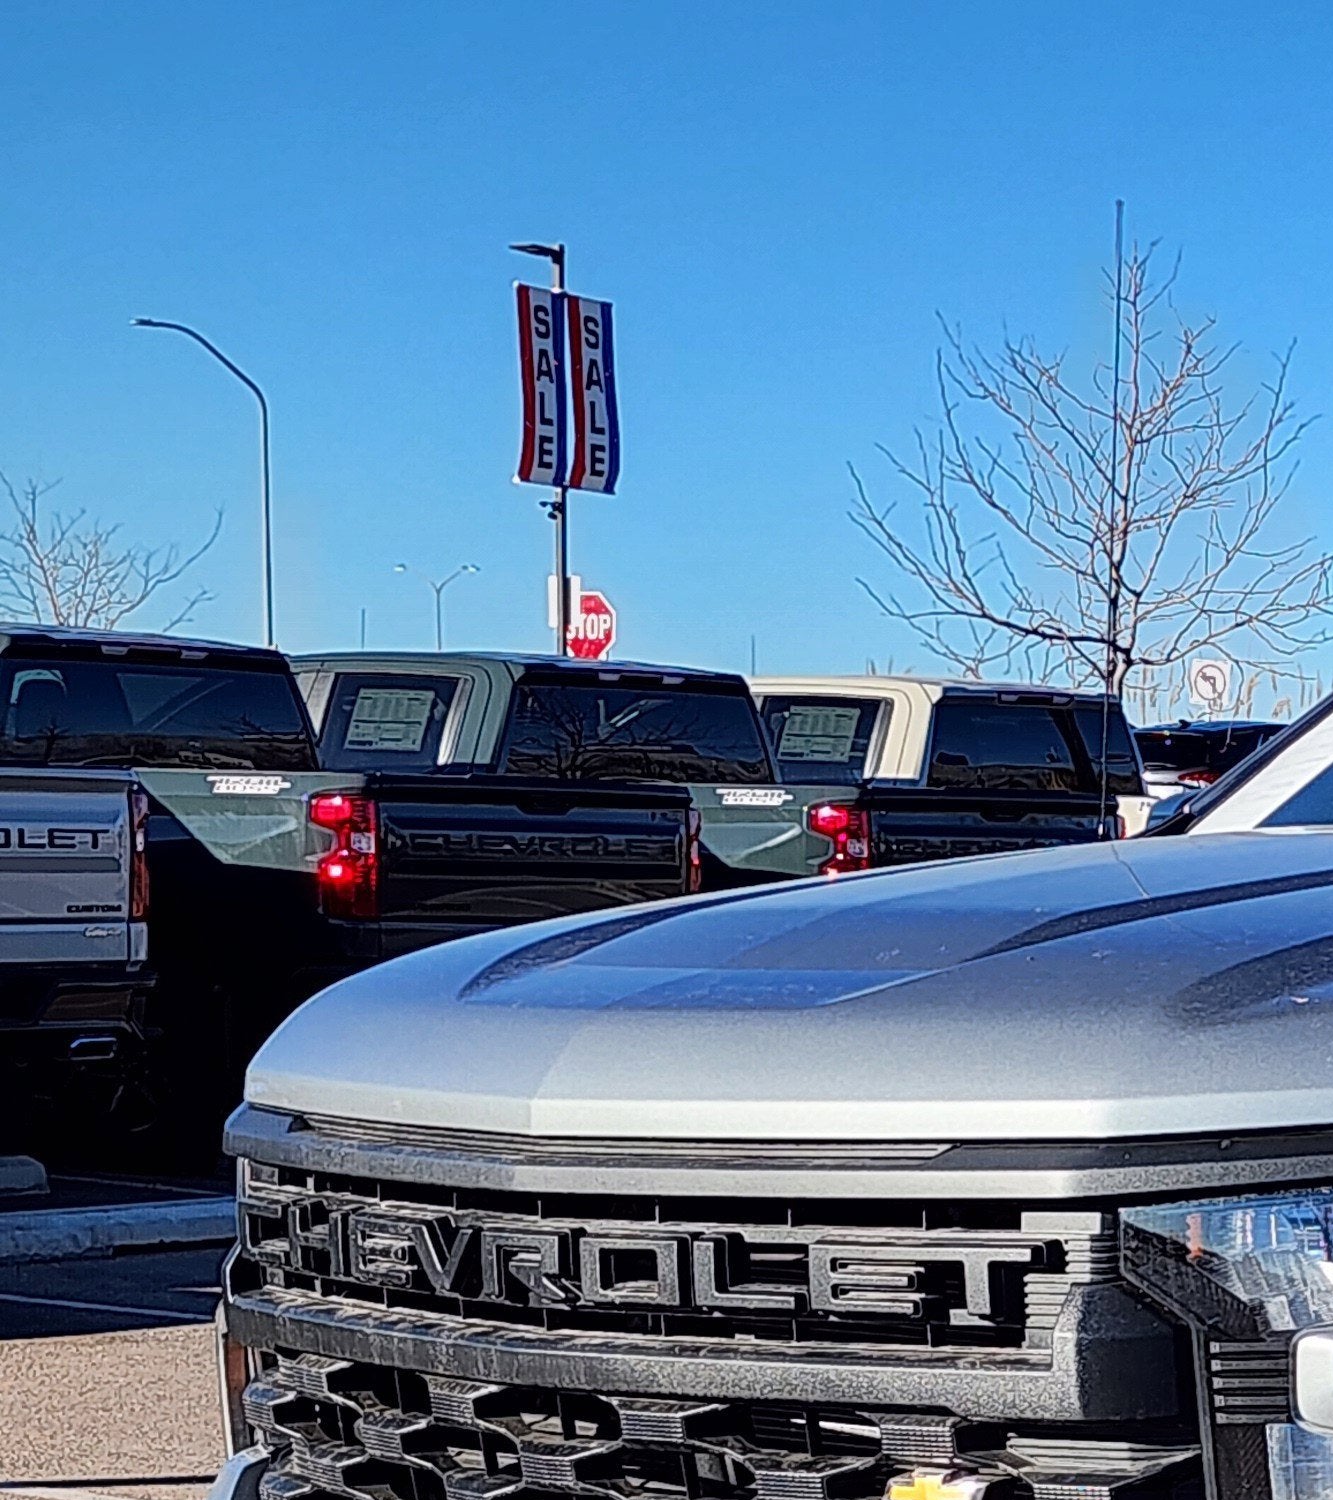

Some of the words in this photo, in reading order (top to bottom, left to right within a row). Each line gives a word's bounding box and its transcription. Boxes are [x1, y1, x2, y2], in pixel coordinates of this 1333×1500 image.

[533, 304, 554, 469] SALE
[583, 315, 606, 478] SALE
[240, 1202, 1034, 1326] CHEVROLET
